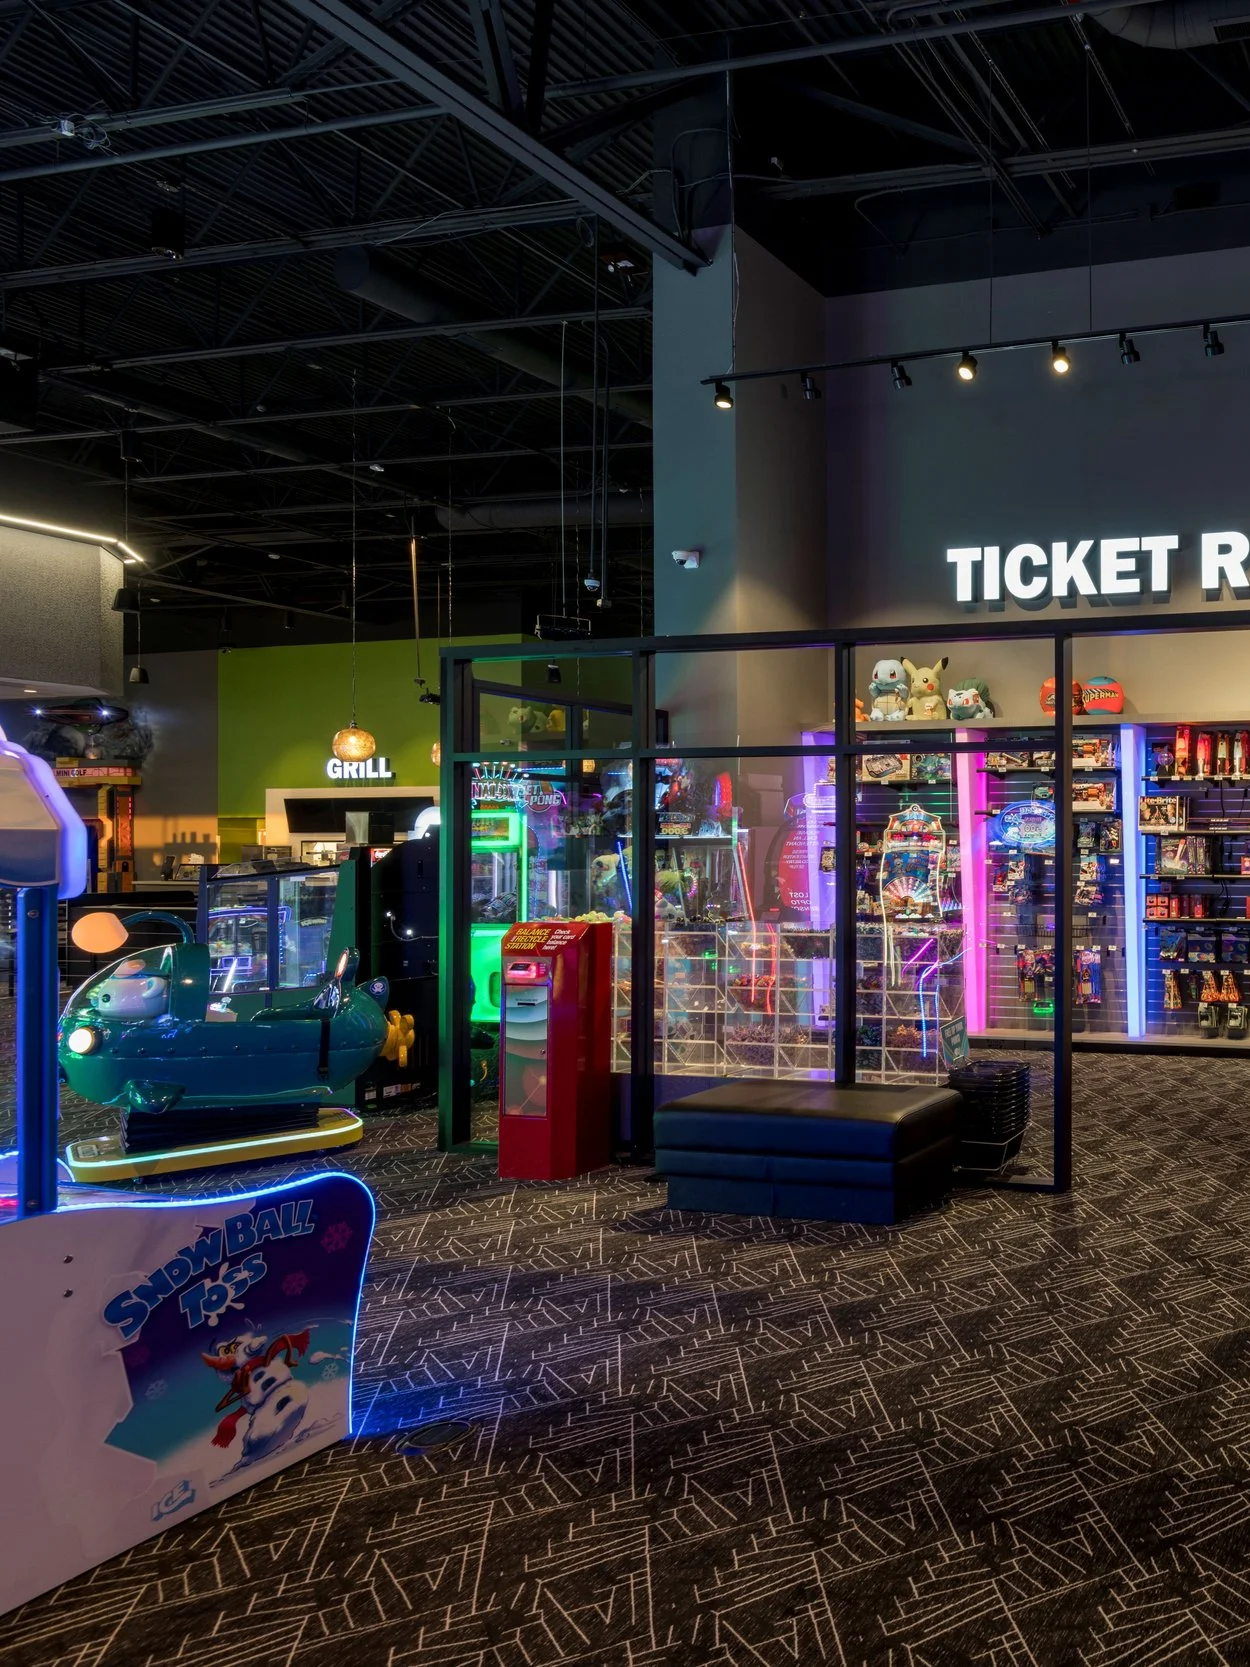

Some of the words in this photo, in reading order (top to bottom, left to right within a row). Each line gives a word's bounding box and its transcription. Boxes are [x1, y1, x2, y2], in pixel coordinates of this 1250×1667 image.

[947, 535, 1179, 602] TICKET
[326, 757, 392, 779] GRILL
[530, 794, 561, 806] PONG
[180, 1252, 268, 1329] TOSS
[151, 1479, 195, 1521] ICE
